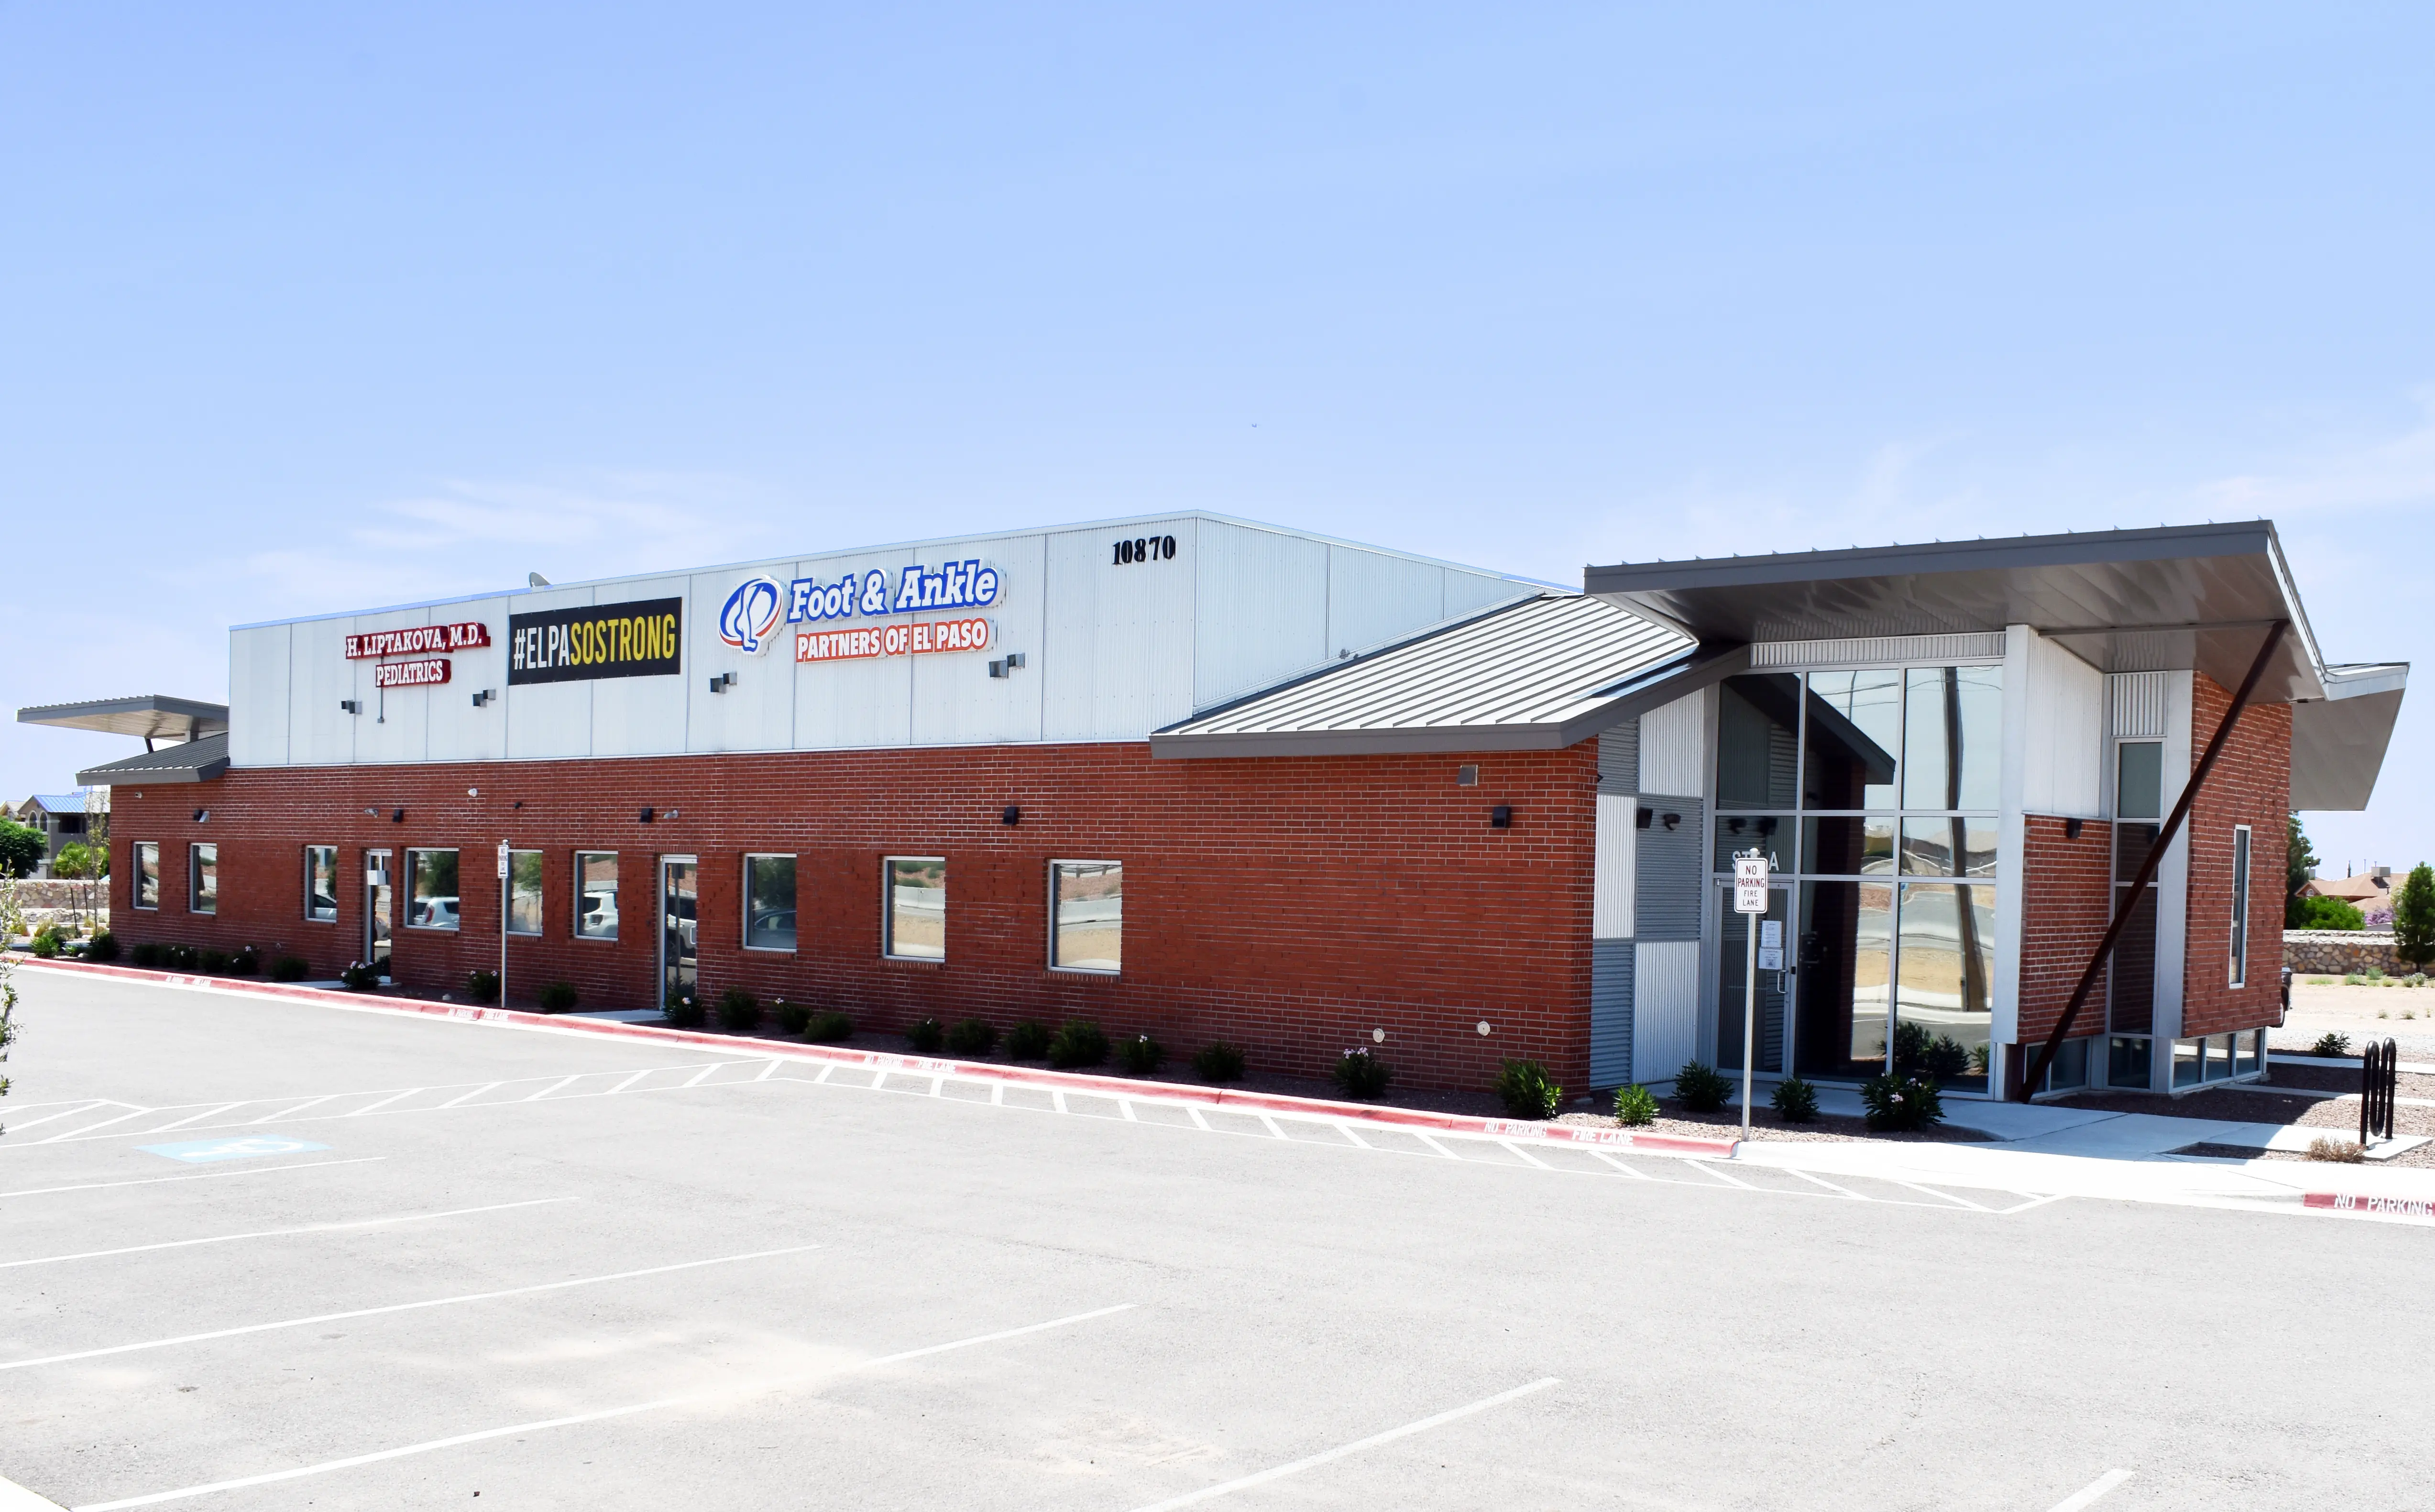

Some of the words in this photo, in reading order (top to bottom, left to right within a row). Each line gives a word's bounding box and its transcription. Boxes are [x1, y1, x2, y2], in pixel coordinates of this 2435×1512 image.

[1112, 536, 1175, 565] 10870
[788, 575, 856, 622] Foot
[860, 570, 888, 615] &
[895, 560, 998, 611] Ankle
[346, 638, 361, 657] H.
[363, 628, 447, 655] LIPTAKOVA,
[450, 624, 482, 646] M.D.
[514, 614, 676, 670] #ELPASOSTRONG
[797, 629, 880, 661] PARTNERS
[885, 626, 908, 654] OF
[912, 624, 932, 651] EL
[936, 619, 987, 650] PASO
[376, 660, 443, 686] PEDIATRICS
[1746, 866, 1757, 875] NO
[1768, 851, 1779, 871] A
[1738, 878, 1765, 888] PARKING
[1484, 1121, 1499, 1133] NO
[1505, 1123, 1547, 1138] PARKING
[1572, 1129, 1596, 1142] FIRE
[1600, 1131, 1634, 1146] LANE
[2334, 1194, 2356, 1209] NO
[2368, 1196, 2433, 1217] PARKING
